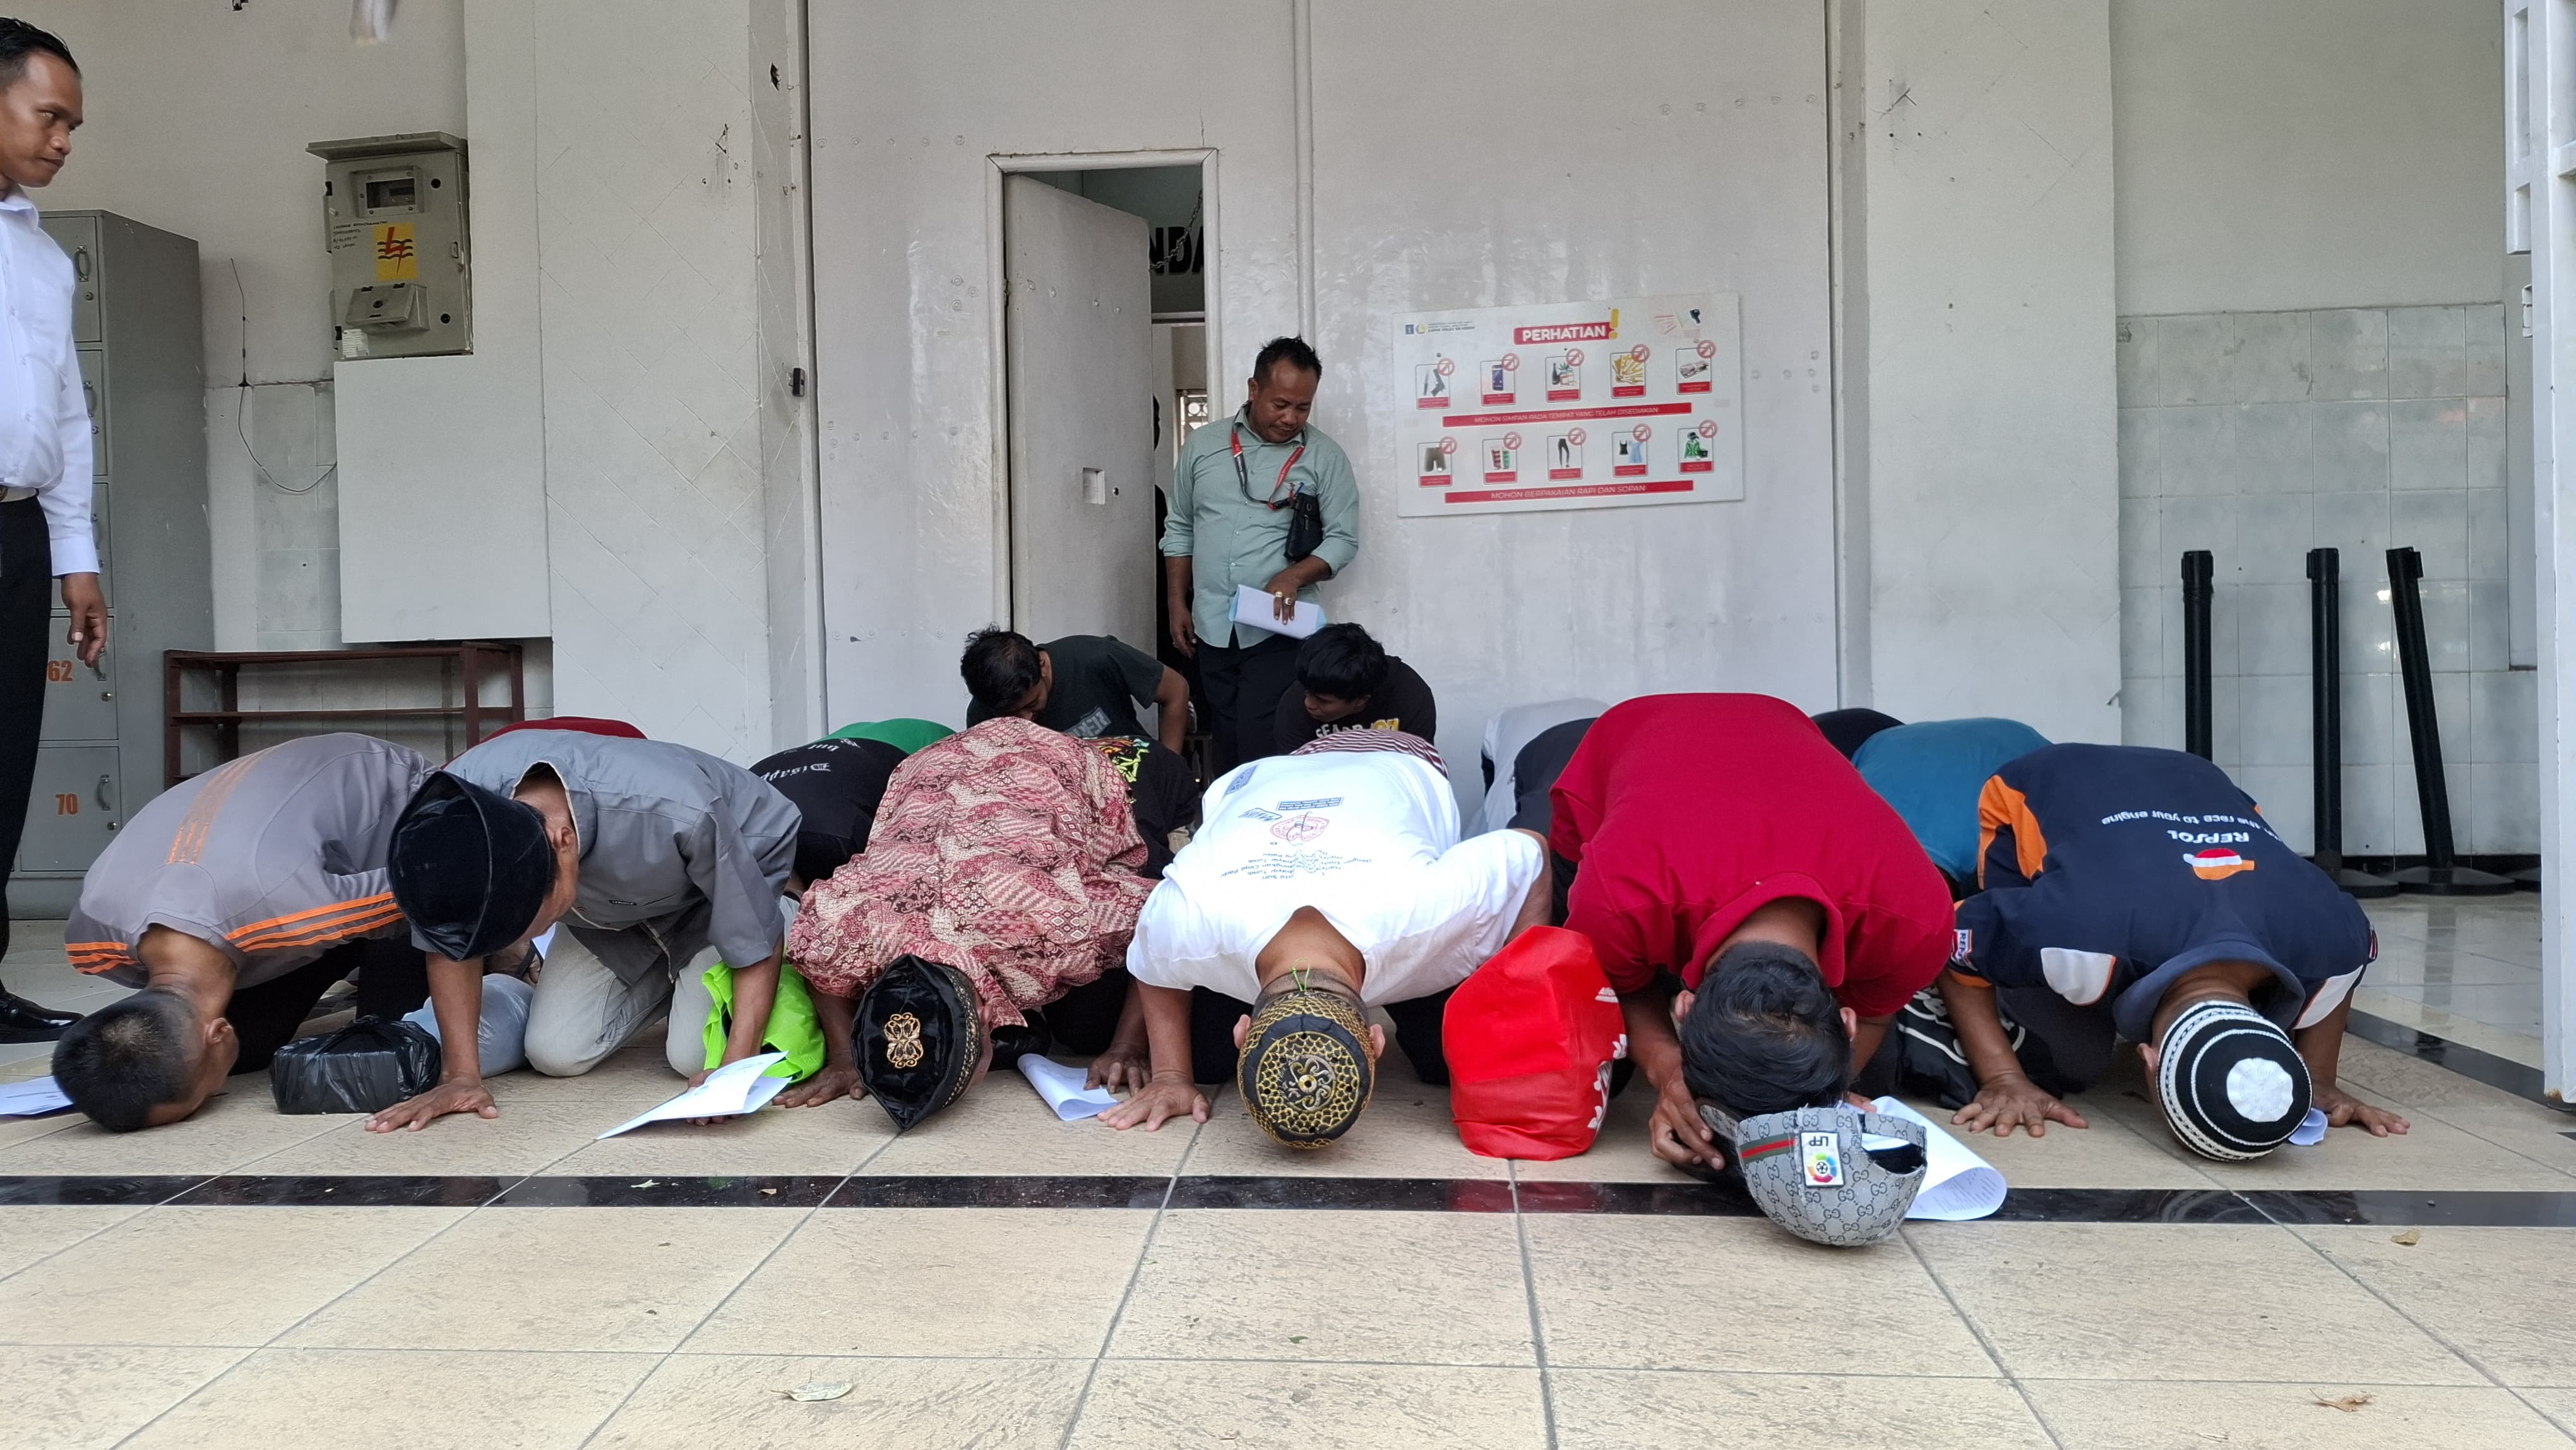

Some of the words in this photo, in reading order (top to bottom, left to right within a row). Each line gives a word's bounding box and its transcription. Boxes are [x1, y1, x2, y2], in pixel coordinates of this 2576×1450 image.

[1522, 325, 1606, 342] PERHATIAN
[1491, 491, 1522, 500] MOHON
[1524, 488, 1575, 498] BERPAKAIAN
[1577, 487, 1595, 495] RAPI
[47, 661, 73, 682] 62
[55, 793, 79, 815] 70
[2101, 810, 2148, 825] engine
[2152, 810, 2179, 824] your
[2183, 815, 2200, 825] to
[2203, 815, 2234, 824] race
[2167, 830, 2250, 844] REPSOL
[1809, 1135, 1829, 1147] LFP
